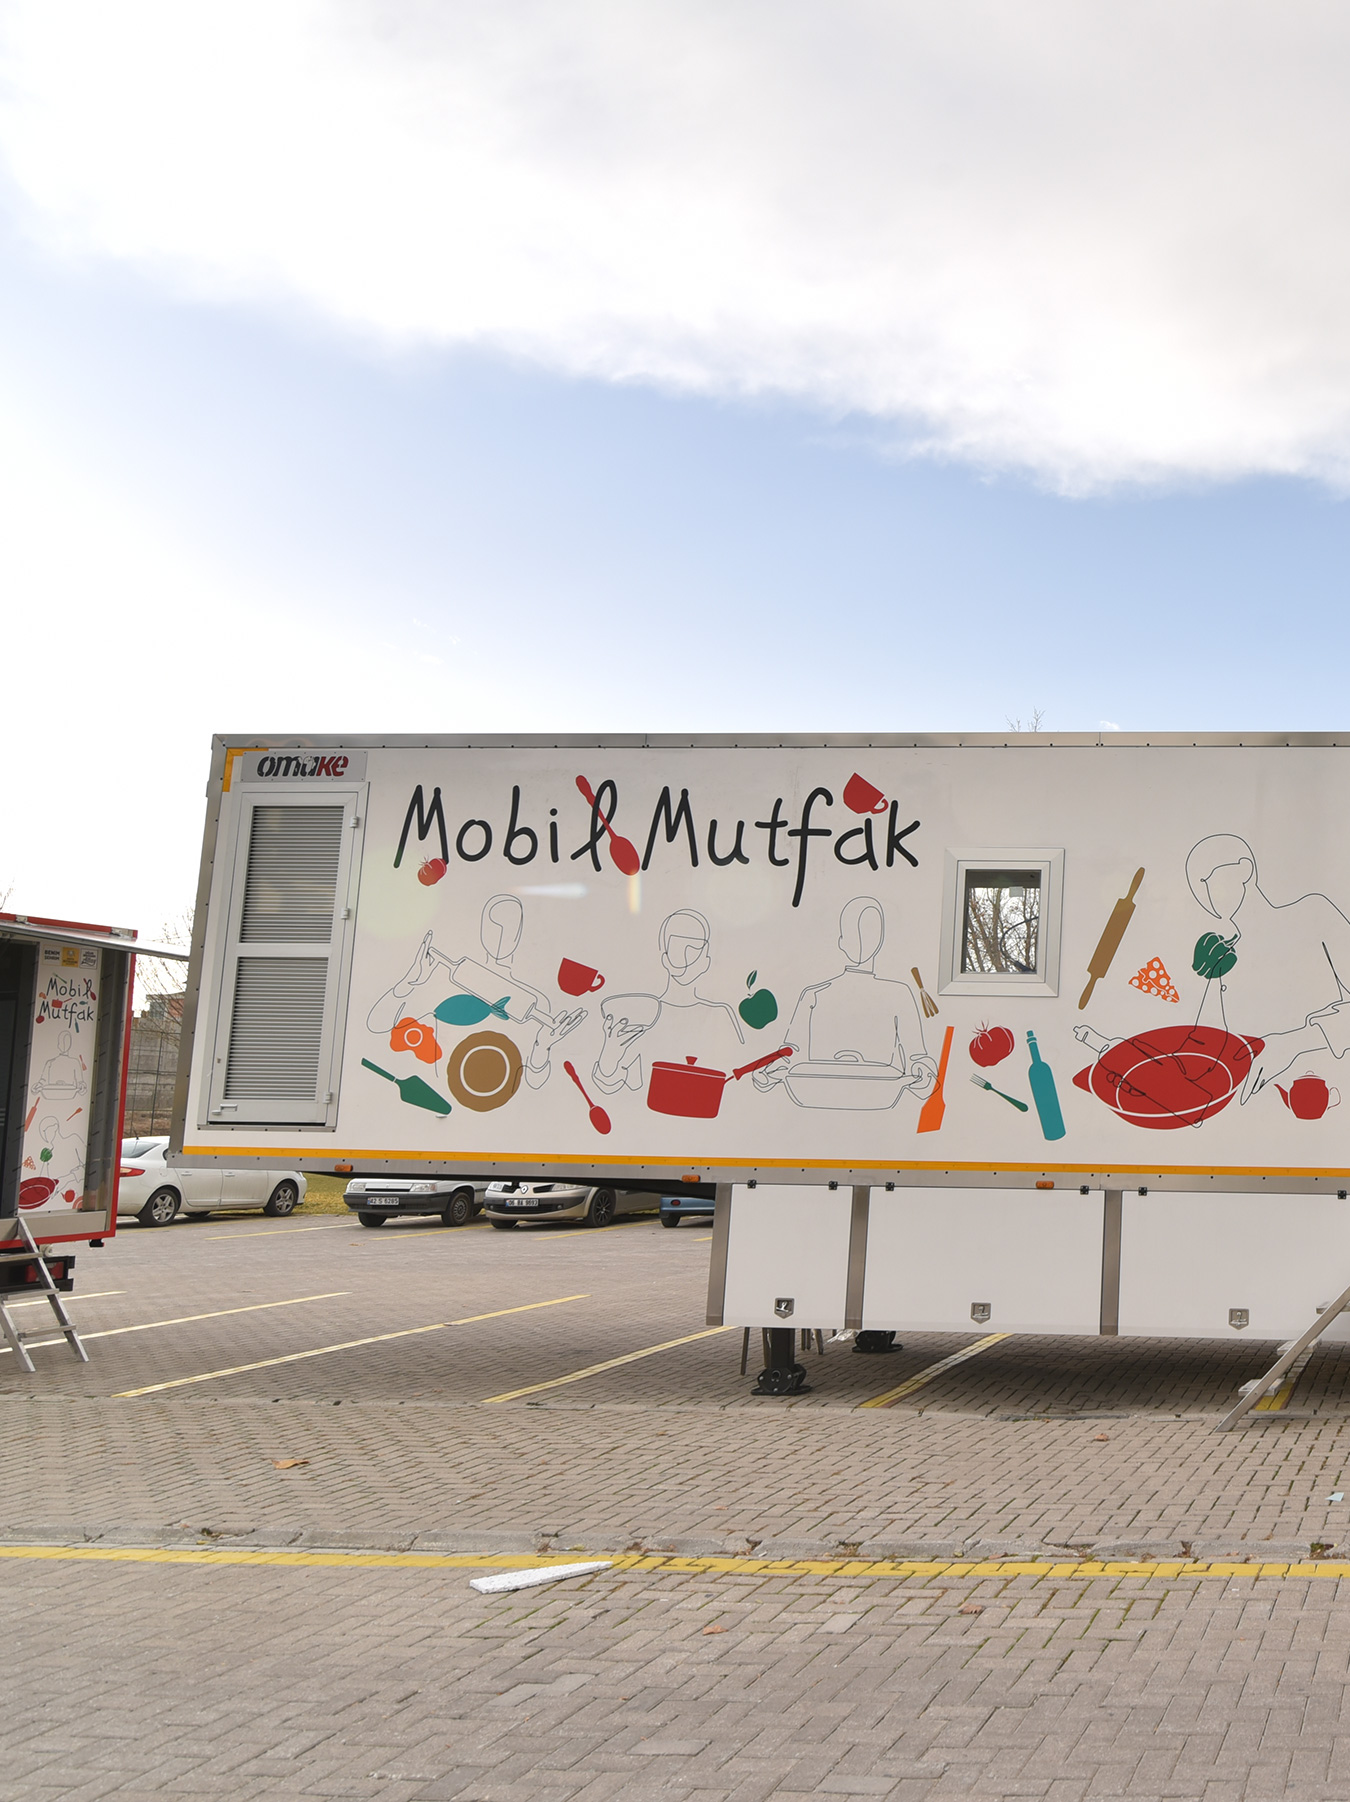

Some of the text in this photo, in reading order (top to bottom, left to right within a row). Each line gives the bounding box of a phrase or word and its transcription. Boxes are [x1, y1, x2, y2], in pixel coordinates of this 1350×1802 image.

[392, 777, 921, 908] Mobil Mutfak
[46, 977, 92, 999] Mobil
[39, 1000, 94, 1028] Mutfak
